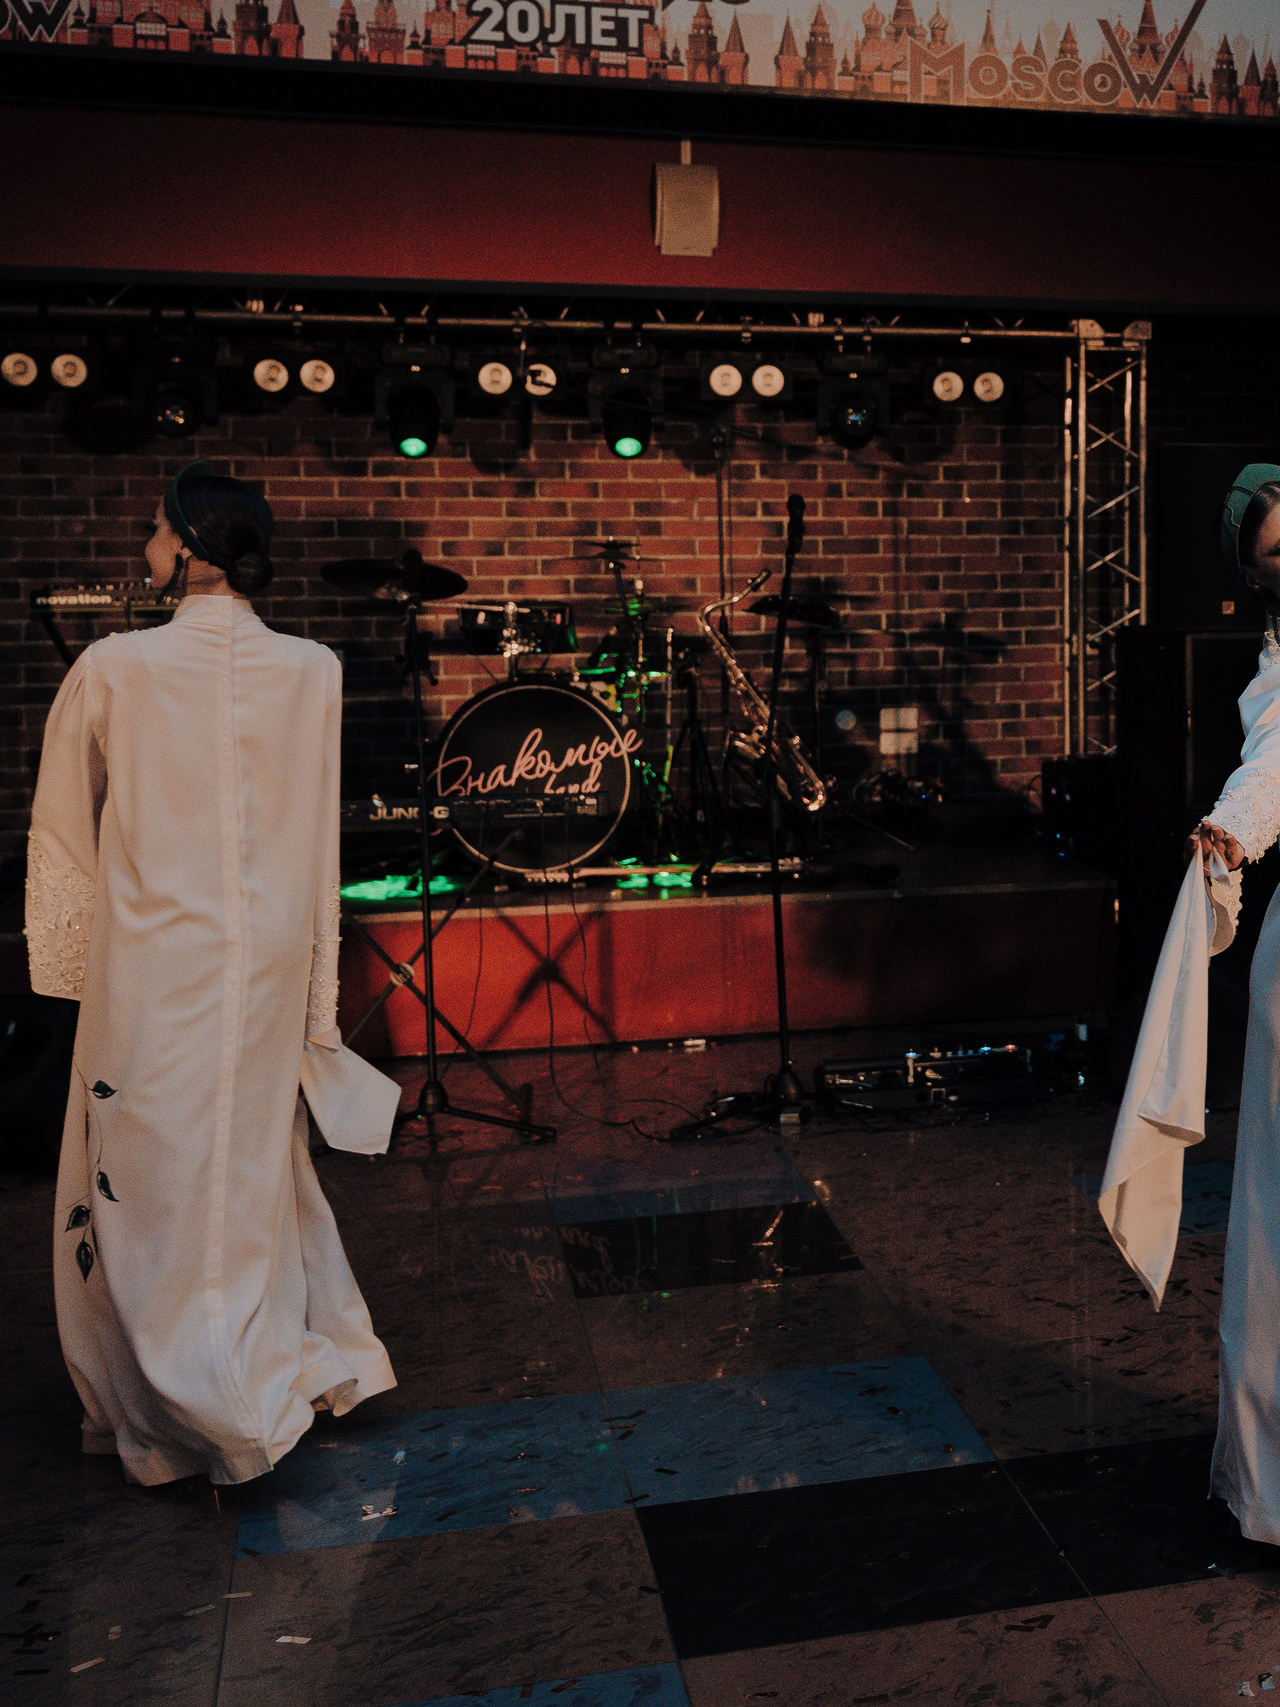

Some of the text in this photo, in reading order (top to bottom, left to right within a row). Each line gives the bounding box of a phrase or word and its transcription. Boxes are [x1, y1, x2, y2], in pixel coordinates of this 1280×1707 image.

[470, 0, 649, 48] 20 ЛЕТ
[370, 806, 449, 820] JUN-G
